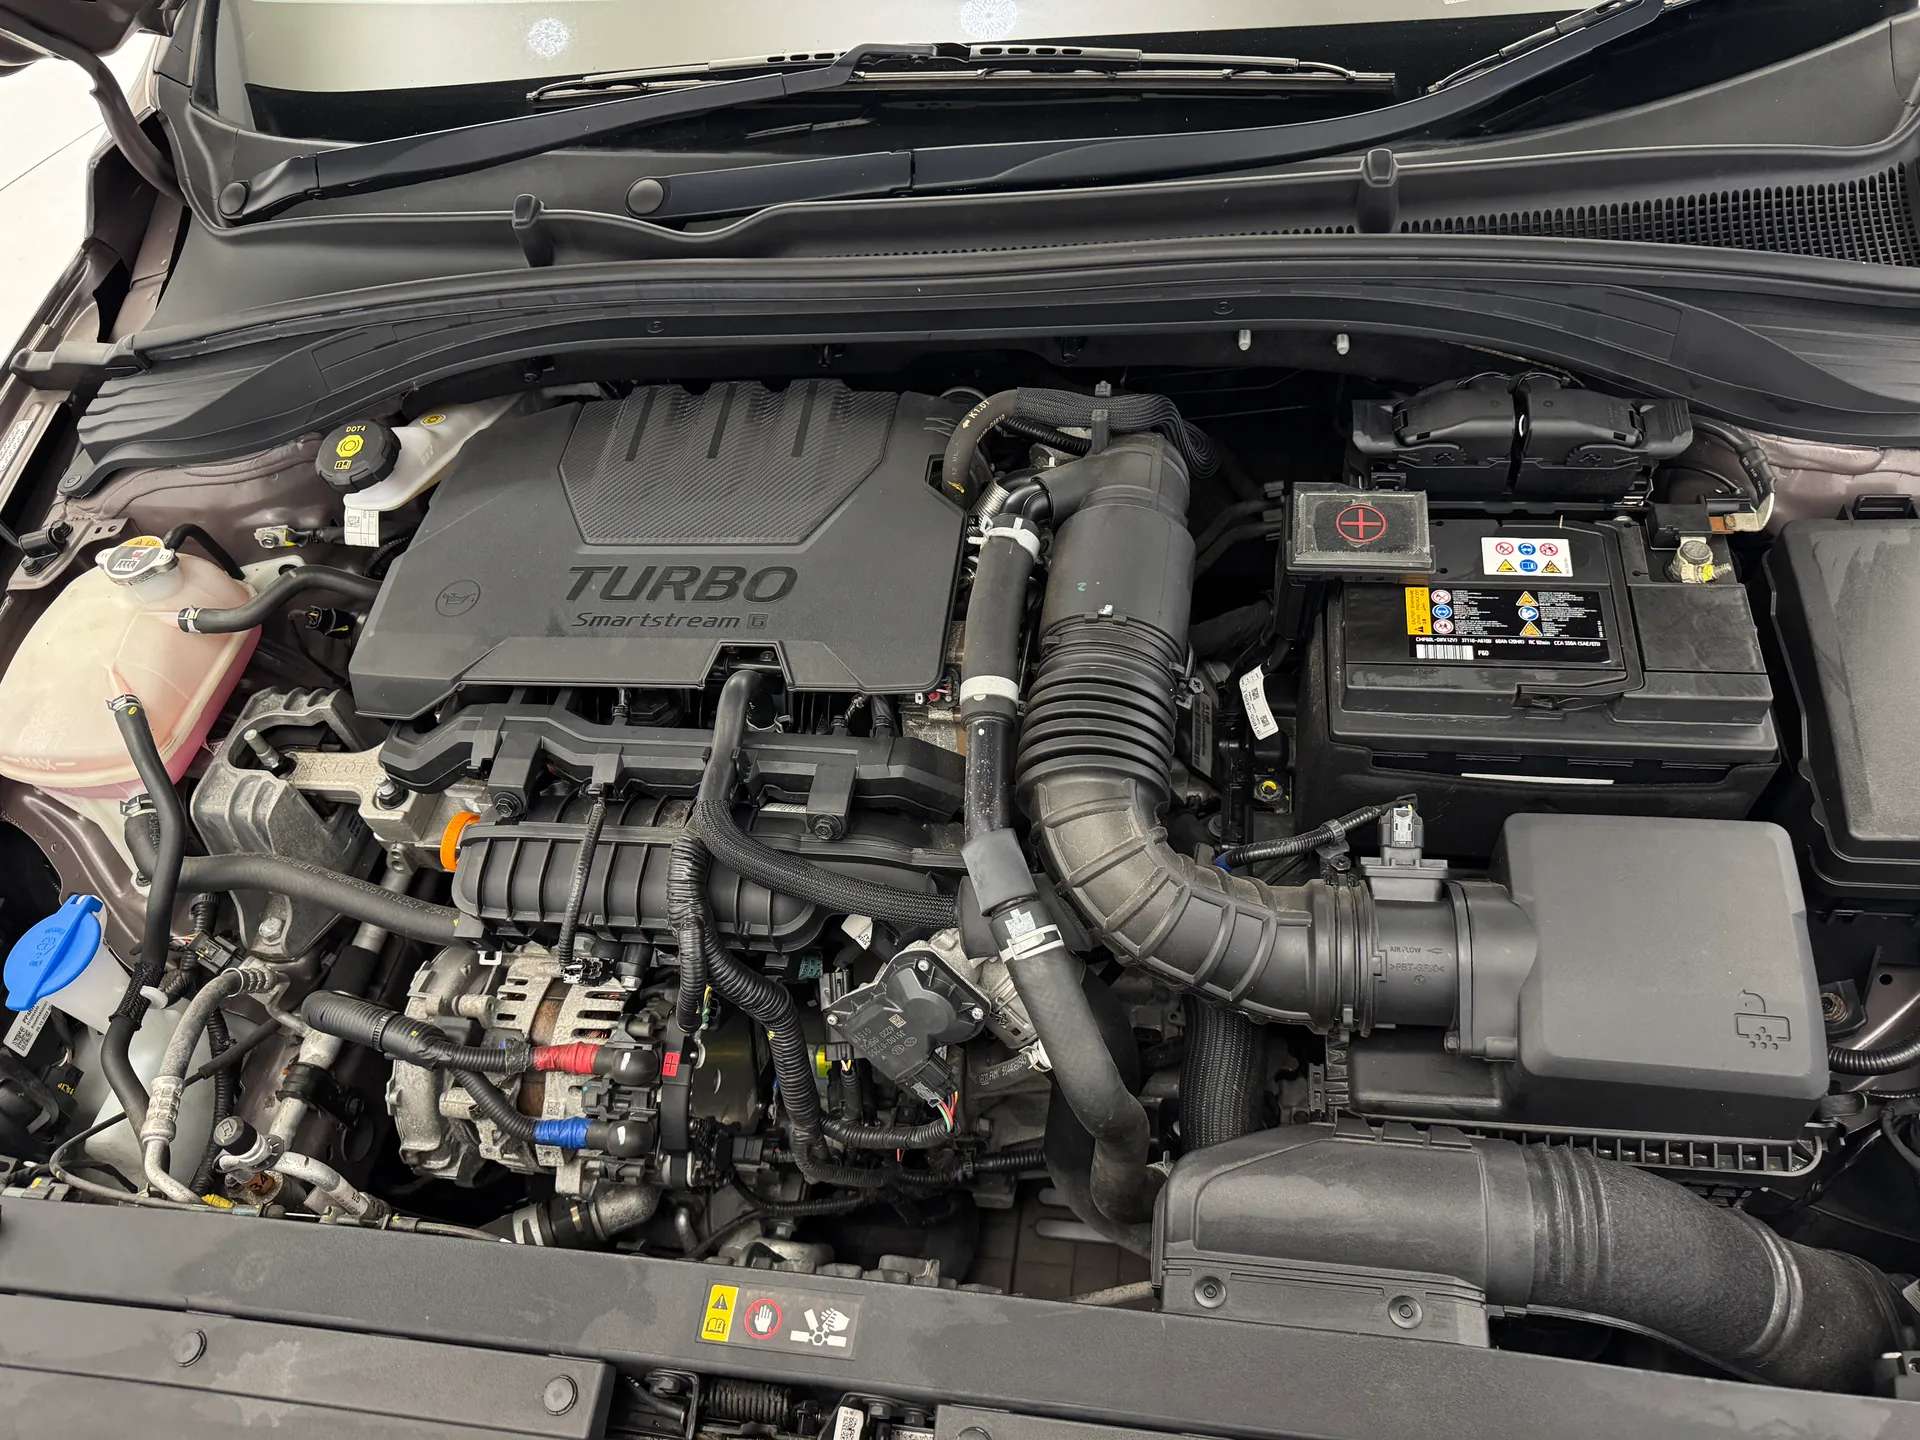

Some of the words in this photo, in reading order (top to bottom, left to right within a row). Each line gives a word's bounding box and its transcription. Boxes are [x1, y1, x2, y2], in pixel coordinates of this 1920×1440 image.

[345, 425, 367, 433] DOT4
[566, 566, 798, 602] TURBO
[571, 612, 741, 628] Smartstream
